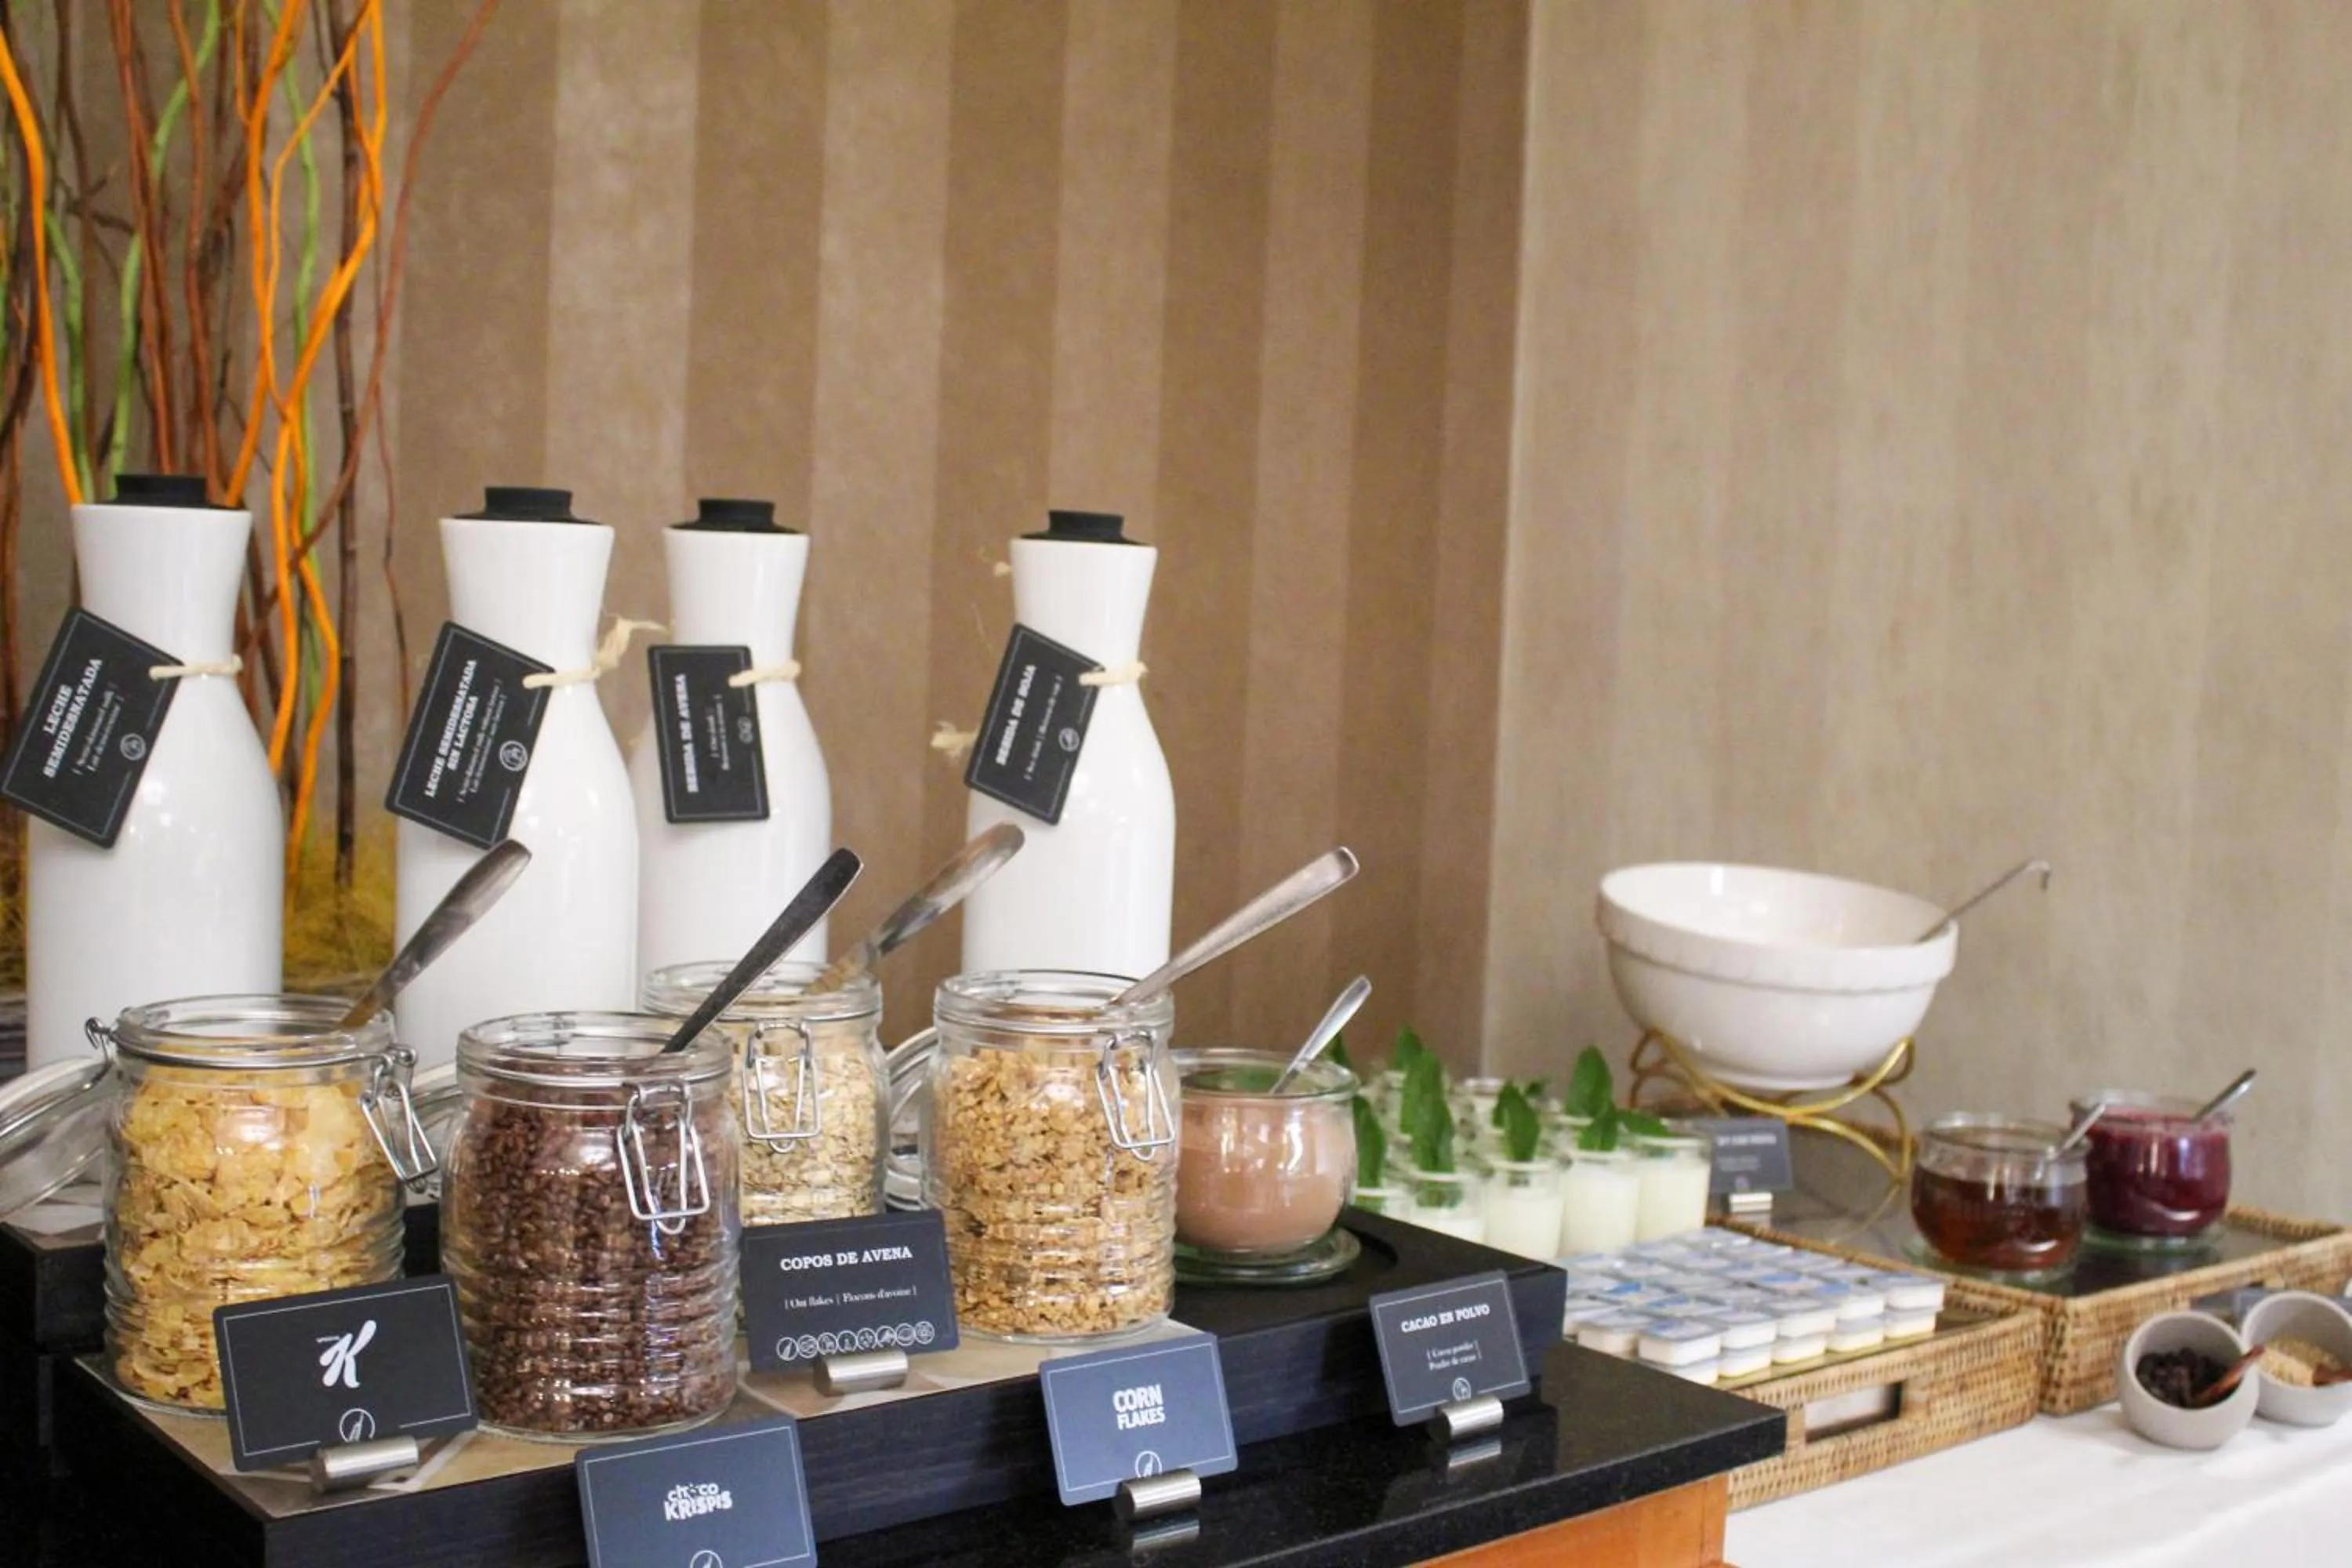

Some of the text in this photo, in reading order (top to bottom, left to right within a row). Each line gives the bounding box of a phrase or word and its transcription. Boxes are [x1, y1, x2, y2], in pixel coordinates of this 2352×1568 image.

[42, 683, 74, 735] LECHE
[42, 656, 103, 778] SEMIDESNATADA
[781, 1247, 913, 1271] COPOS DE AVENA
[1401, 1316, 1438, 1333] CACAO
[1455, 1304, 1490, 1321] POLVO
[1112, 1385, 1163, 1412] CORN
[1116, 1406, 1166, 1430] FLAKES
[664, 1490, 733, 1521] KRISPIS
